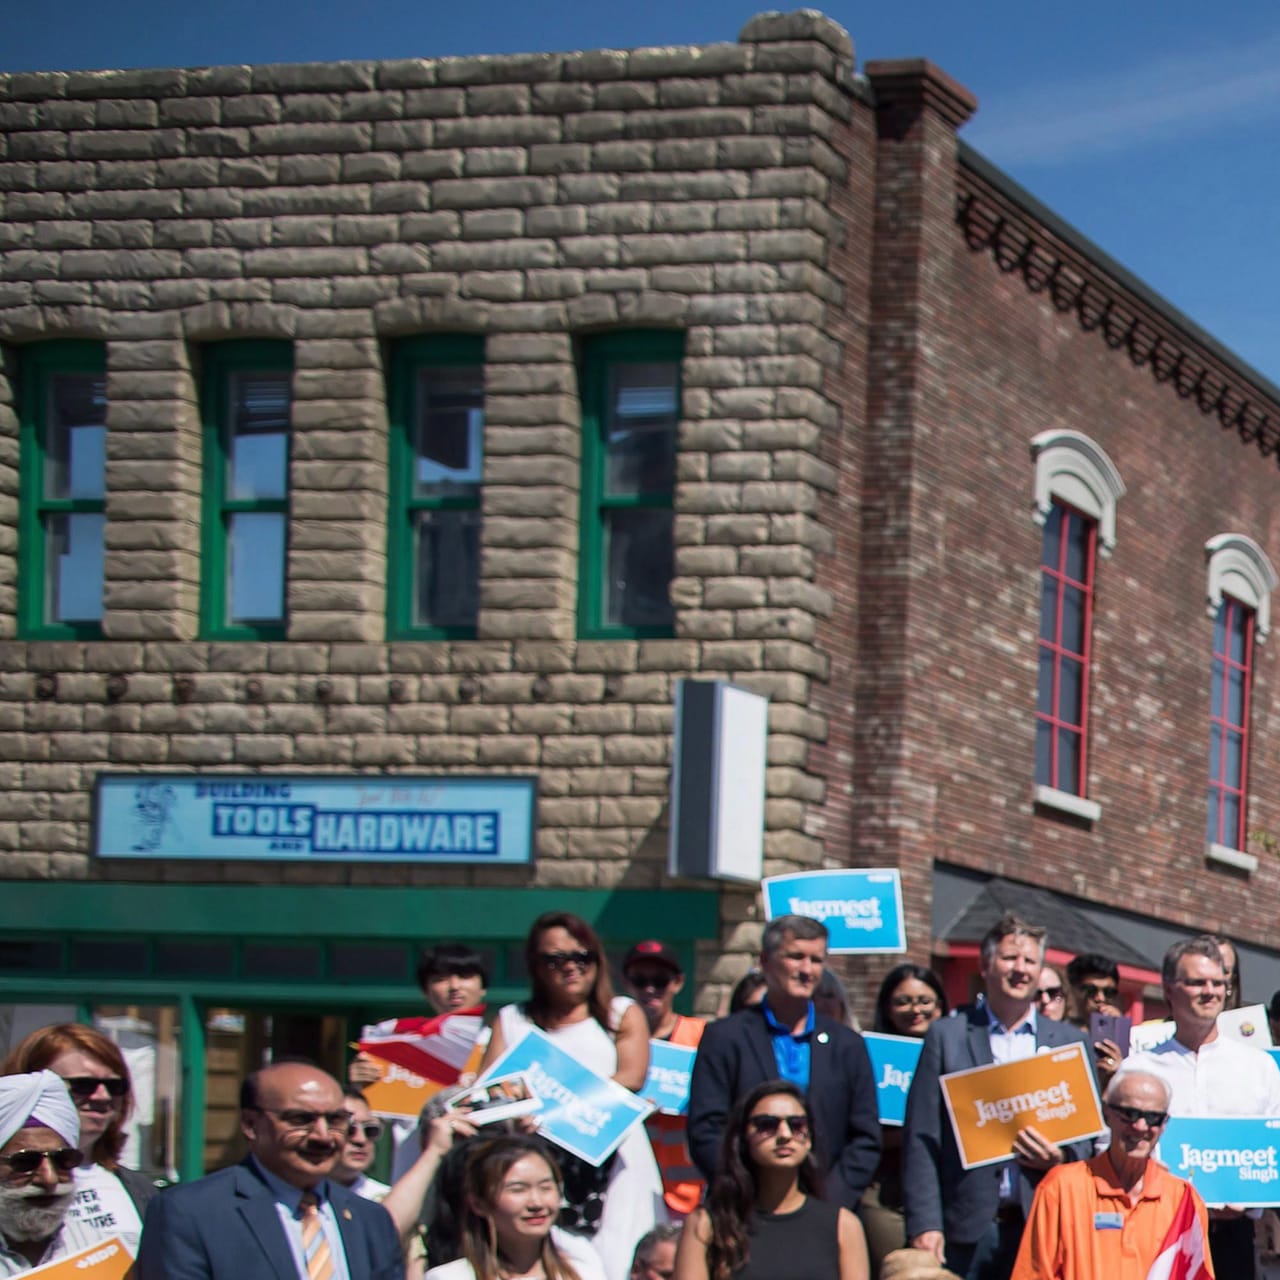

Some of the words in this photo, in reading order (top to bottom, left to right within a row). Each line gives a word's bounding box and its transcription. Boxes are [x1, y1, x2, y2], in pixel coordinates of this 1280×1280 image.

[194, 783, 291, 798] BUILDING
[216, 806, 313, 835] TOOLS
[317, 814, 495, 851] HARDWARE
[973, 1080, 1074, 1128] Jagmeet
[1036, 1102, 1077, 1123] Singh
[1178, 1143, 1278, 1173] Jagmeet
[1238, 1165, 1279, 1184] Singh
